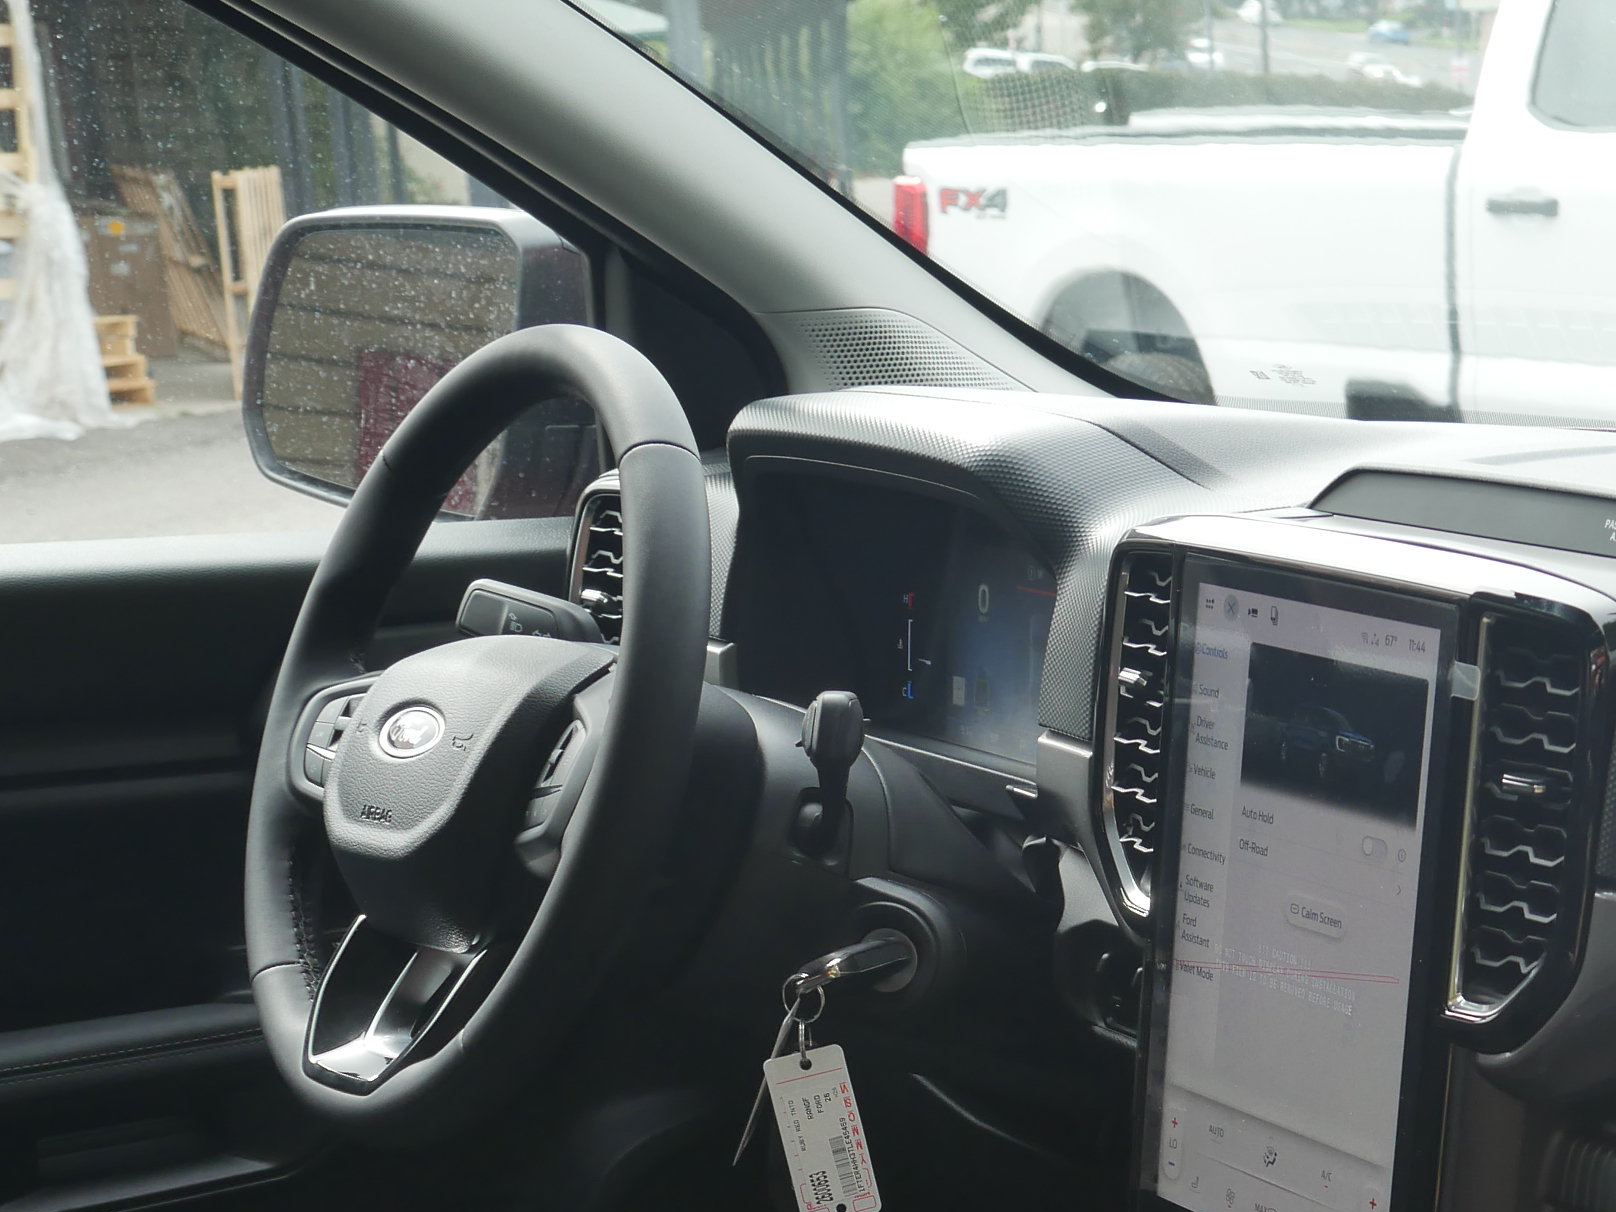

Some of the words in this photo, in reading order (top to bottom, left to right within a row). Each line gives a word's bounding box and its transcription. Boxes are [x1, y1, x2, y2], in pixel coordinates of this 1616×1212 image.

[940, 187, 1008, 214] FX4
[1202, 645, 1229, 661] Controls
[1409, 639, 1426, 653] 11:44
[1199, 684, 1220, 699] Sound
[1197, 716, 1215, 732] Driver
[1195, 733, 1229, 752] Assistance
[1193, 764, 1216, 781] Vehicle
[1190, 803, 1215, 821] General
[1241, 806, 1258, 821] Auto
[1259, 809, 1274, 826] Hold
[1187, 843, 1227, 866] Connectivity
[1239, 839, 1269, 858] Off-Road
[1185, 874, 1215, 894] Software
[1184, 891, 1210, 909] Updates
[1182, 913, 1198, 929] Ford
[1300, 905, 1318, 925] Calm
[1319, 912, 1343, 930] Screen
[1181, 929, 1211, 949] Assistant
[1179, 960, 1195, 979] Valet
[1196, 965, 1215, 983] Mode
[814, 1095, 823, 1113] FORD
[1208, 1124, 1225, 1140] AUTO
[1169, 1138, 1178, 1150] LO
[1321, 1169, 1333, 1183] A/C
